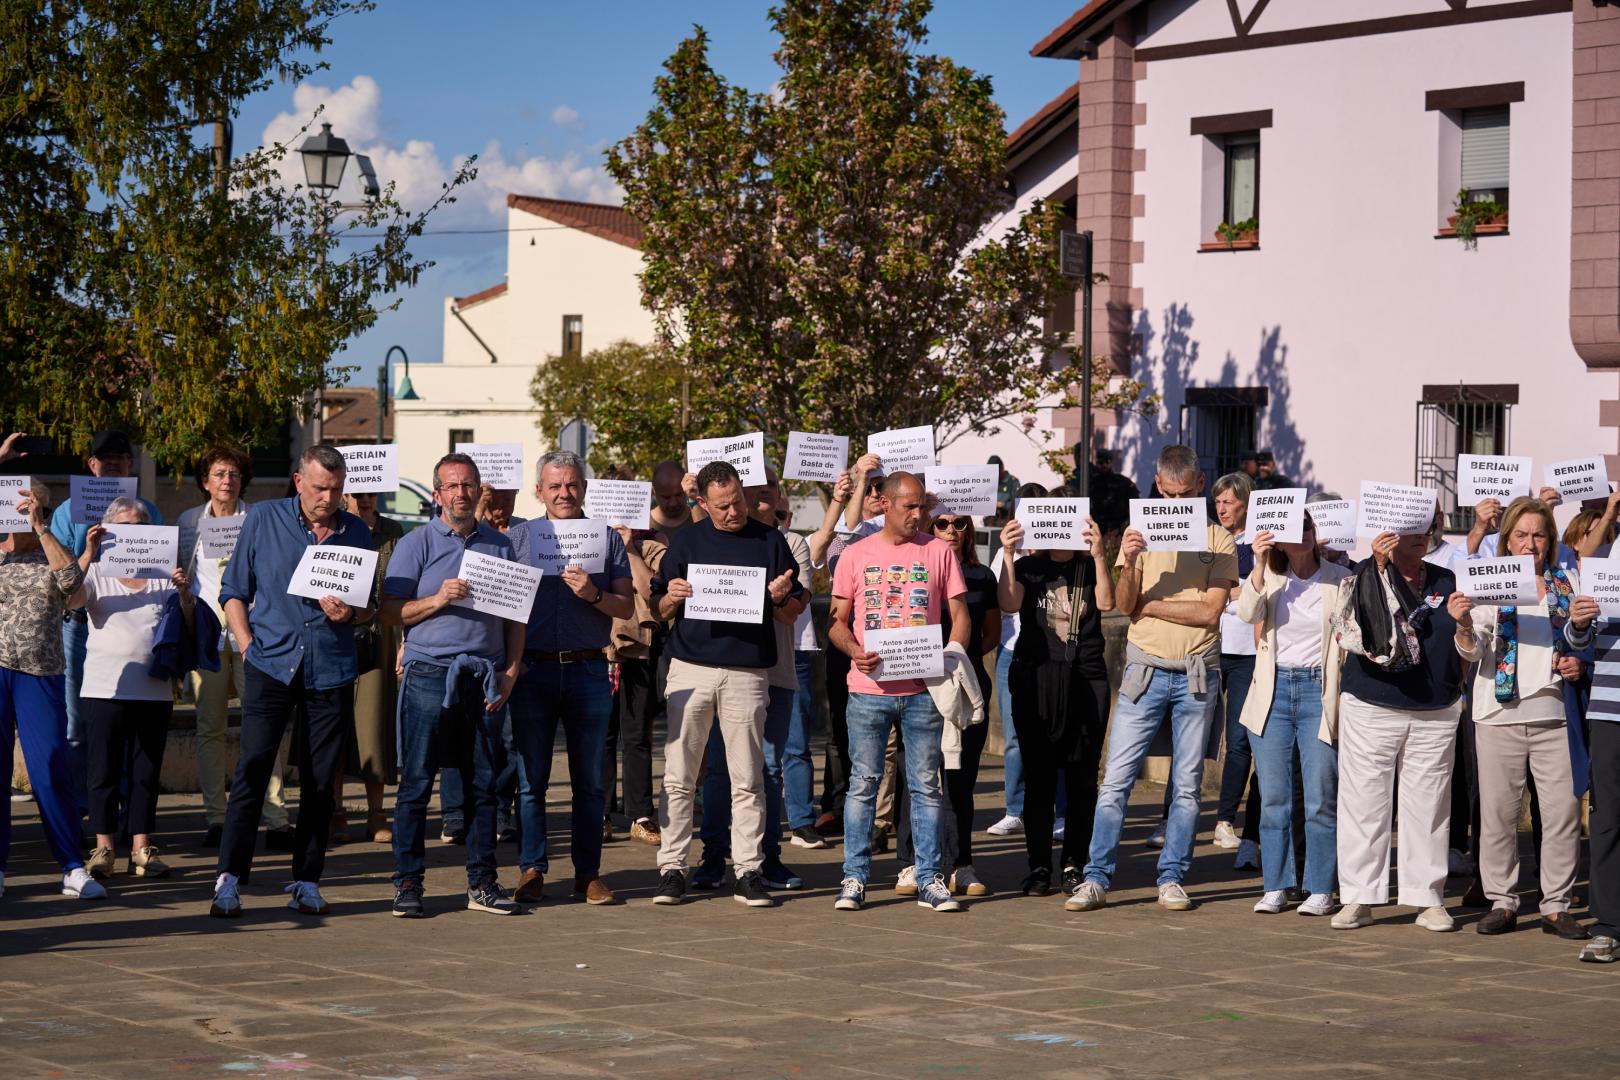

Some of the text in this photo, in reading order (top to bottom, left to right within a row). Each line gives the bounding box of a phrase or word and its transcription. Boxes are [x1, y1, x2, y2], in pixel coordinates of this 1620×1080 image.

[725, 440, 754, 454] BERIAIN
[343, 451, 386, 459] BERIAIN
[346, 465, 370, 473] LIBRE
[1471, 461, 1519, 472] BERIAIN
[1554, 463, 1595, 476] BERIAIN
[349, 476, 382, 484] OKUPAS
[1473, 476, 1498, 484] LIBRE
[1559, 478, 1581, 487] LIBRE
[1562, 486, 1594, 496] OKUPAS
[1256, 496, 1294, 505] BERIAIN
[1028, 505, 1077, 514] BERIAIN
[1142, 506, 1193, 515] BERIAIN
[1147, 522, 1175, 530] LIBRE
[1034, 532, 1071, 540] OKUPAS
[1150, 534, 1188, 542] OKUPAS
[124, 538, 148, 546] ayuda
[556, 542, 582, 550] okupa"
[109, 556, 170, 565] Ropero solidario
[313, 551, 363, 566] BERIAIN
[311, 566, 355, 581] LIBRE DE
[466, 563, 496, 574] ocupando
[511, 575, 536, 584] vivienda
[696, 568, 758, 577] AYUNTAMIENTO
[1469, 564, 1521, 576] BERIAIN
[1594, 572, 1606, 580] "El
[310, 578, 350, 593] OKUPAS
[466, 579, 489, 588] espacio
[1474, 581, 1518, 591] LIBRE DE
[1594, 585, 1619, 593] puede
[480, 588, 522, 603] función social
